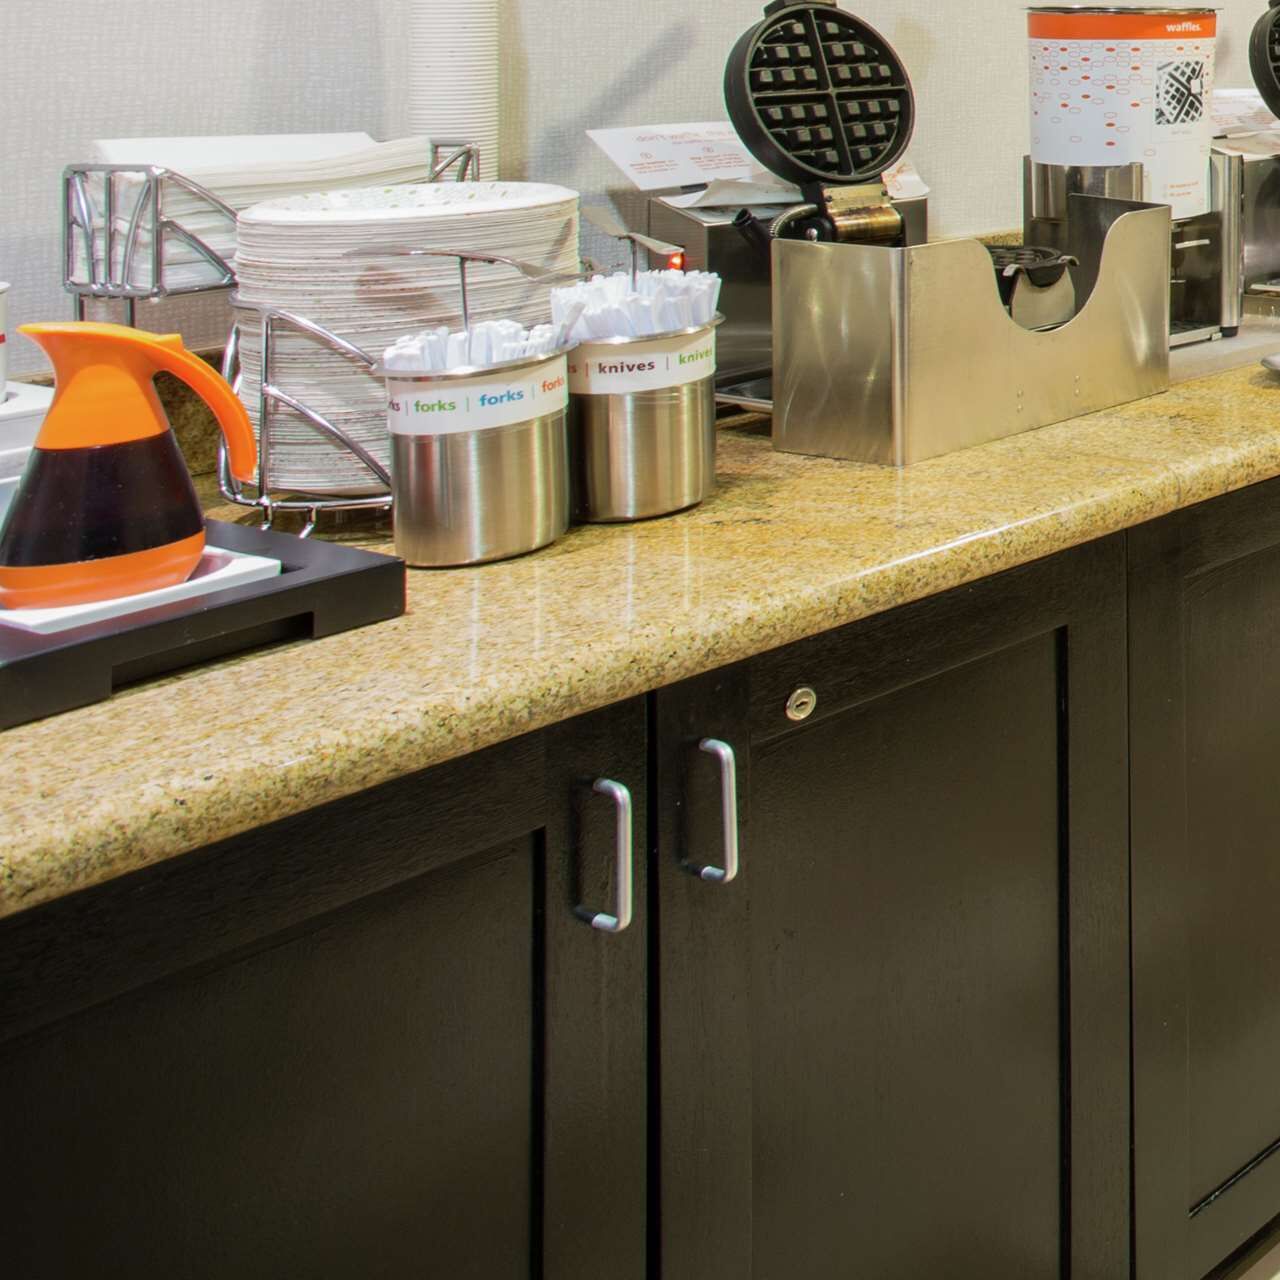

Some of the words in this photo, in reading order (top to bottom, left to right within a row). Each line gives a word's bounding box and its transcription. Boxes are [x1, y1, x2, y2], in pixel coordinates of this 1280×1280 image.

[598, 360, 656, 375] knives
[414, 399, 457, 413] forks
[479, 389, 525, 407] forks
[542, 376, 564, 393] fork
